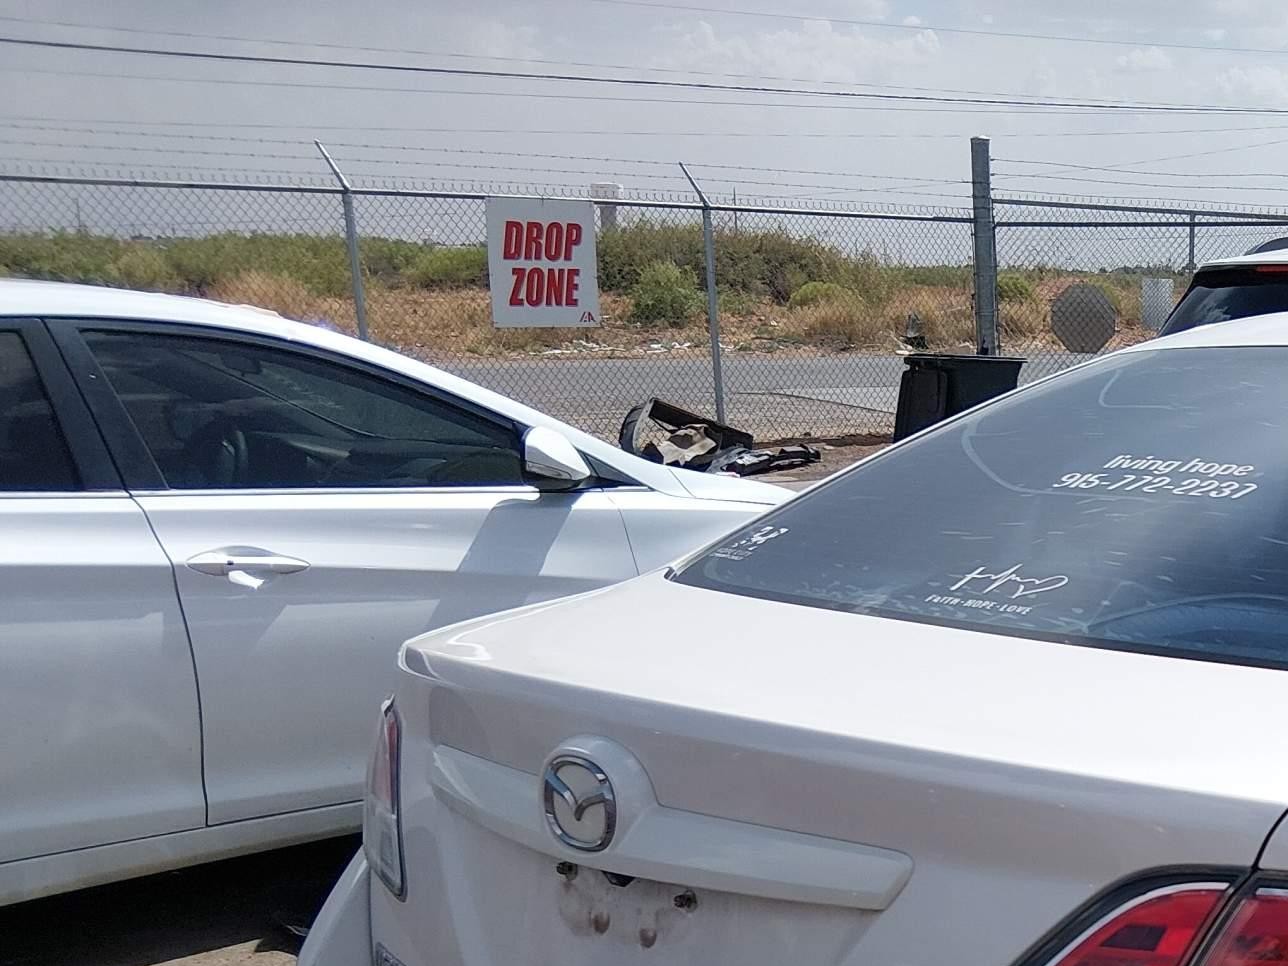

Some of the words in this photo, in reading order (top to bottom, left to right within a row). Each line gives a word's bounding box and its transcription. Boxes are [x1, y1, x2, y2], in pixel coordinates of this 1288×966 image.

[503, 221, 583, 262] DROP
[509, 267, 581, 308] ZONE
[1103, 455, 1182, 475] living
[1179, 458, 1254, 478] hope
[1052, 472, 1258, 499] 915-772-2237
